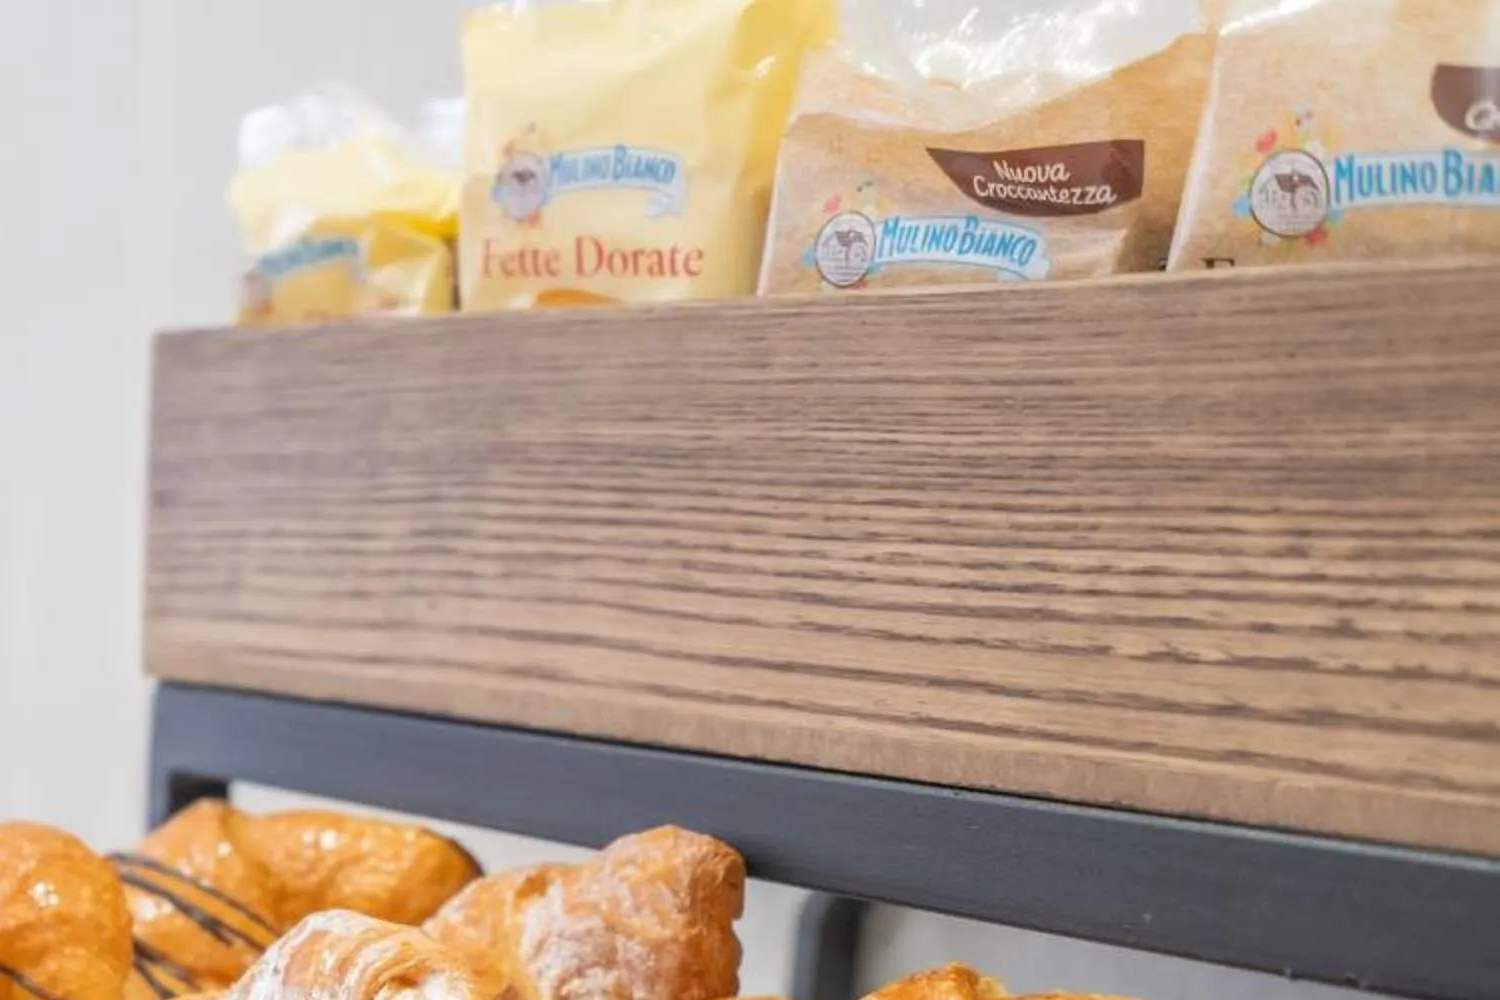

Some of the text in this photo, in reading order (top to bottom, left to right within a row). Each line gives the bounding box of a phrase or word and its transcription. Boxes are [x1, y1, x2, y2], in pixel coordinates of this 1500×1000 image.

[973, 175, 1118, 205] Croccantezza
[992, 159, 1071, 182] Nuova
[1333, 147, 1500, 203] MULINO BIA
[481, 235, 704, 279] Fette Dorate
[878, 214, 1037, 267] MULINO BIANCO
